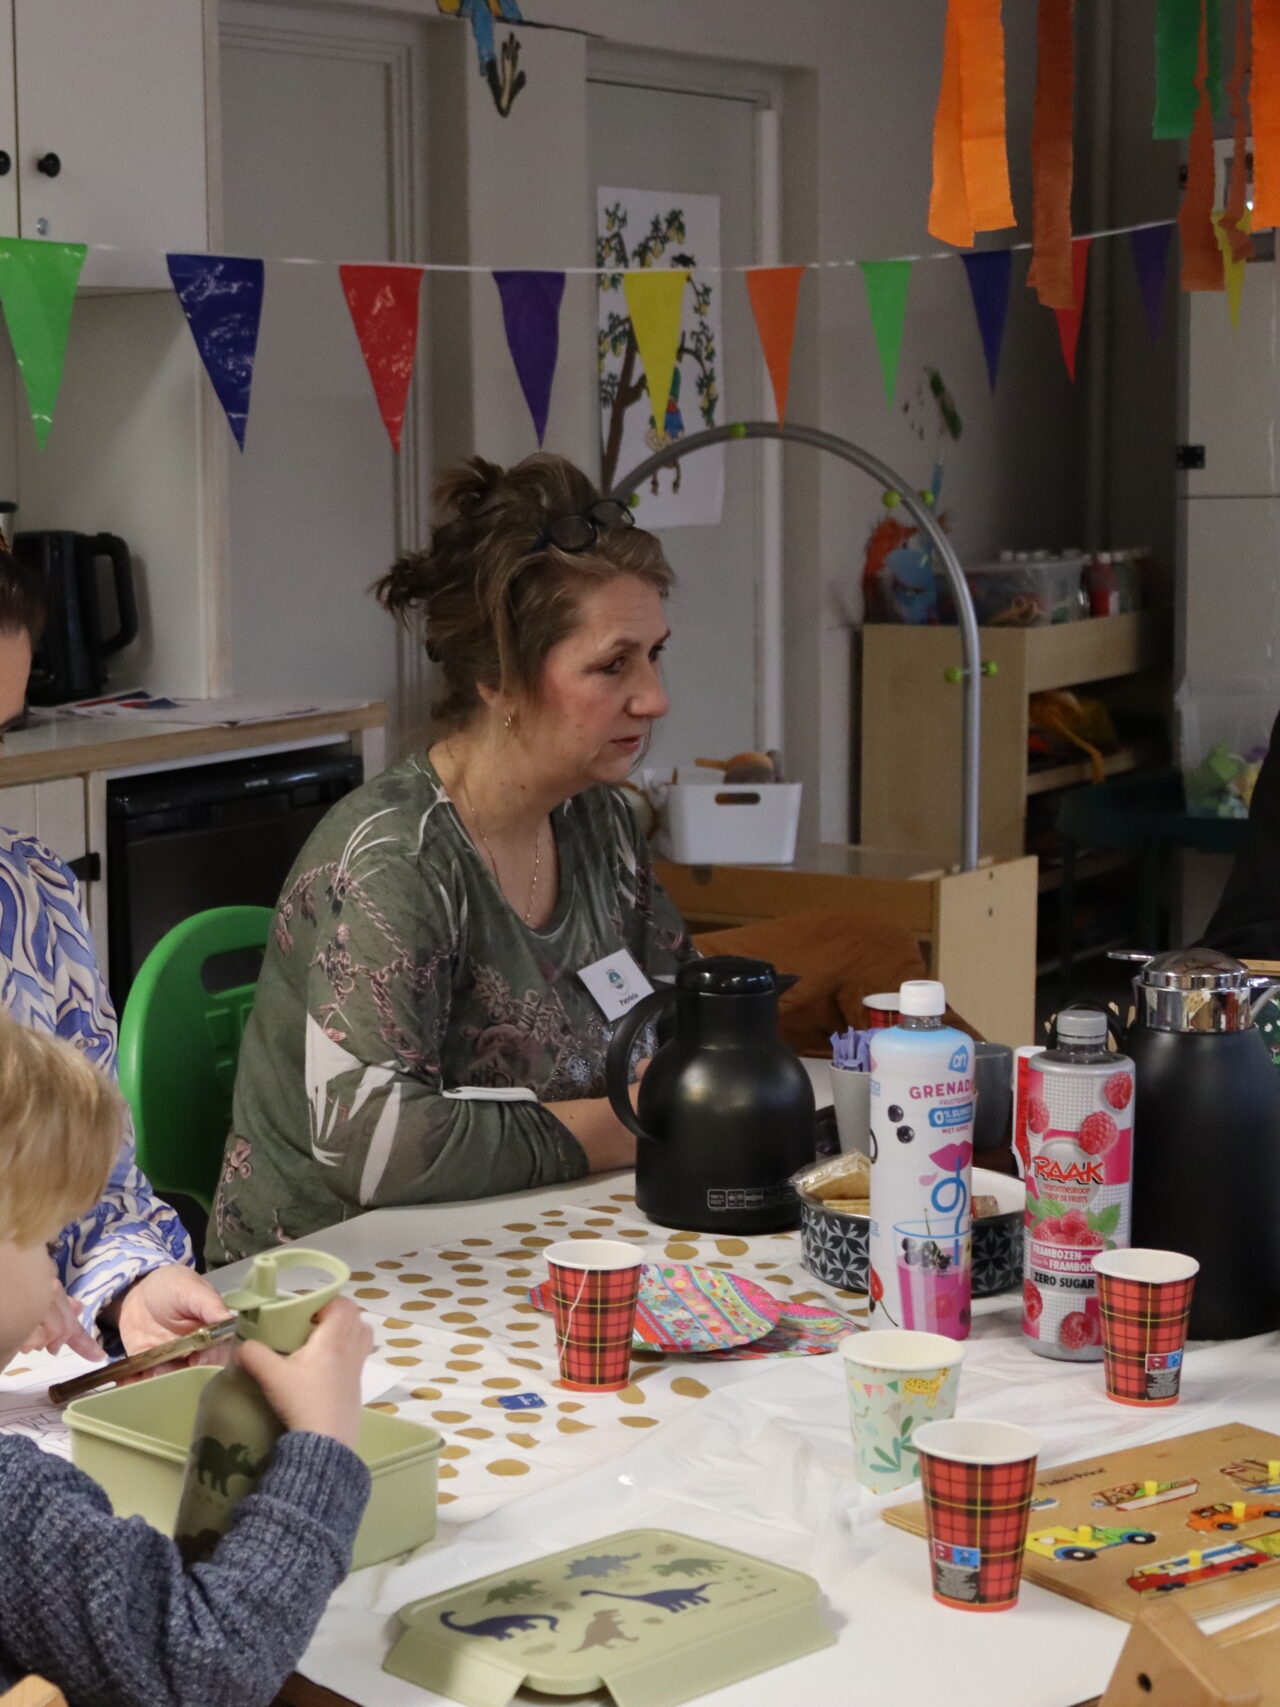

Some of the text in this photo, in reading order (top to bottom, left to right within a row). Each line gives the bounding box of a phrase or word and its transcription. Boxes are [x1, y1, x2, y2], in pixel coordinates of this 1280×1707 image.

[909, 1079, 975, 1099] GRENAD
[1032, 1155, 1105, 1184] RAAK
[1032, 1244, 1081, 1260] FRAMBOZEN
[1049, 1259, 1094, 1272] FRAMBOIS
[1034, 1271, 1095, 1289] ZERO SUGAR
